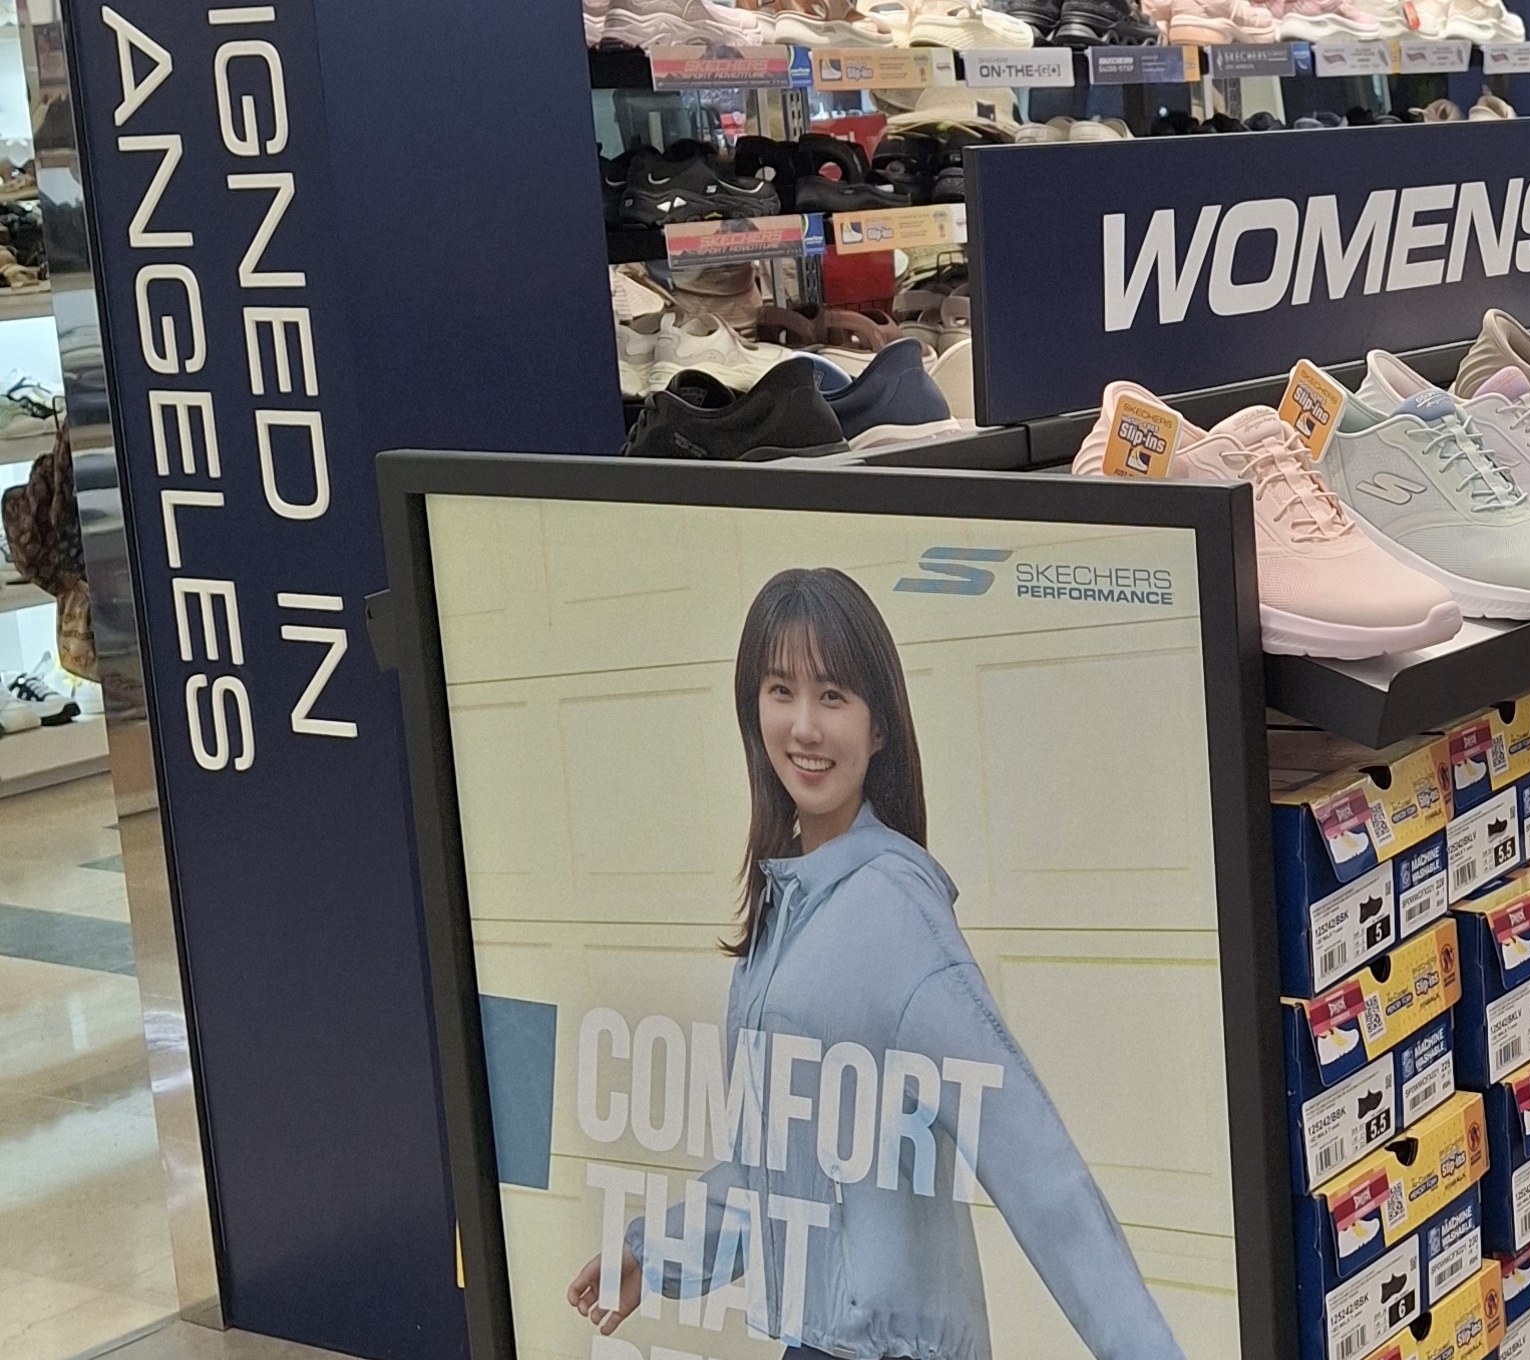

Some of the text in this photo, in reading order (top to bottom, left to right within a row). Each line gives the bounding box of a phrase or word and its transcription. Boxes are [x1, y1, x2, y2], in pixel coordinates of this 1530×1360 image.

[683, 58, 769, 73] SKECHERS
[1223, 49, 1267, 62] SKECHERS
[700, 231, 783, 247] SKECHERS
[101, 5, 255, 774] ANGELES
[1299, 368, 1338, 406] SKECHERS
[1122, 402, 1173, 429] SKECHERS
[1292, 384, 1330, 426] Slip-ins
[1118, 421, 1168, 454] Slip-ins
[1015, 562, 1174, 591] SKECHERS
[1016, 583, 1175, 608] PERFORMANCE
[276, 593, 359, 740] IN
[1410, 845, 1441, 871] MACHINE
[1497, 843, 1513, 864] 5.5
[1374, 922, 1384, 942] 5
[1414, 970, 1440, 997] Slip-ins
[1414, 1027, 1446, 1058] MACHINE
[576, 1006, 1005, 1206] COMFORT
[1308, 1104, 1347, 1137] 125242/BBK
[1369, 1115, 1387, 1140] 5.5
[1440, 1151, 1467, 1178] Slip-ins
[1441, 1205, 1473, 1236] MACHINE
[585, 1162, 831, 1347] THAT
[1468, 1234, 1479, 1250] 230
[1330, 1292, 1370, 1328] 125242/BBK
[1397, 1299, 1407, 1318] 6
[1456, 1320, 1483, 1349] Slip-ins
